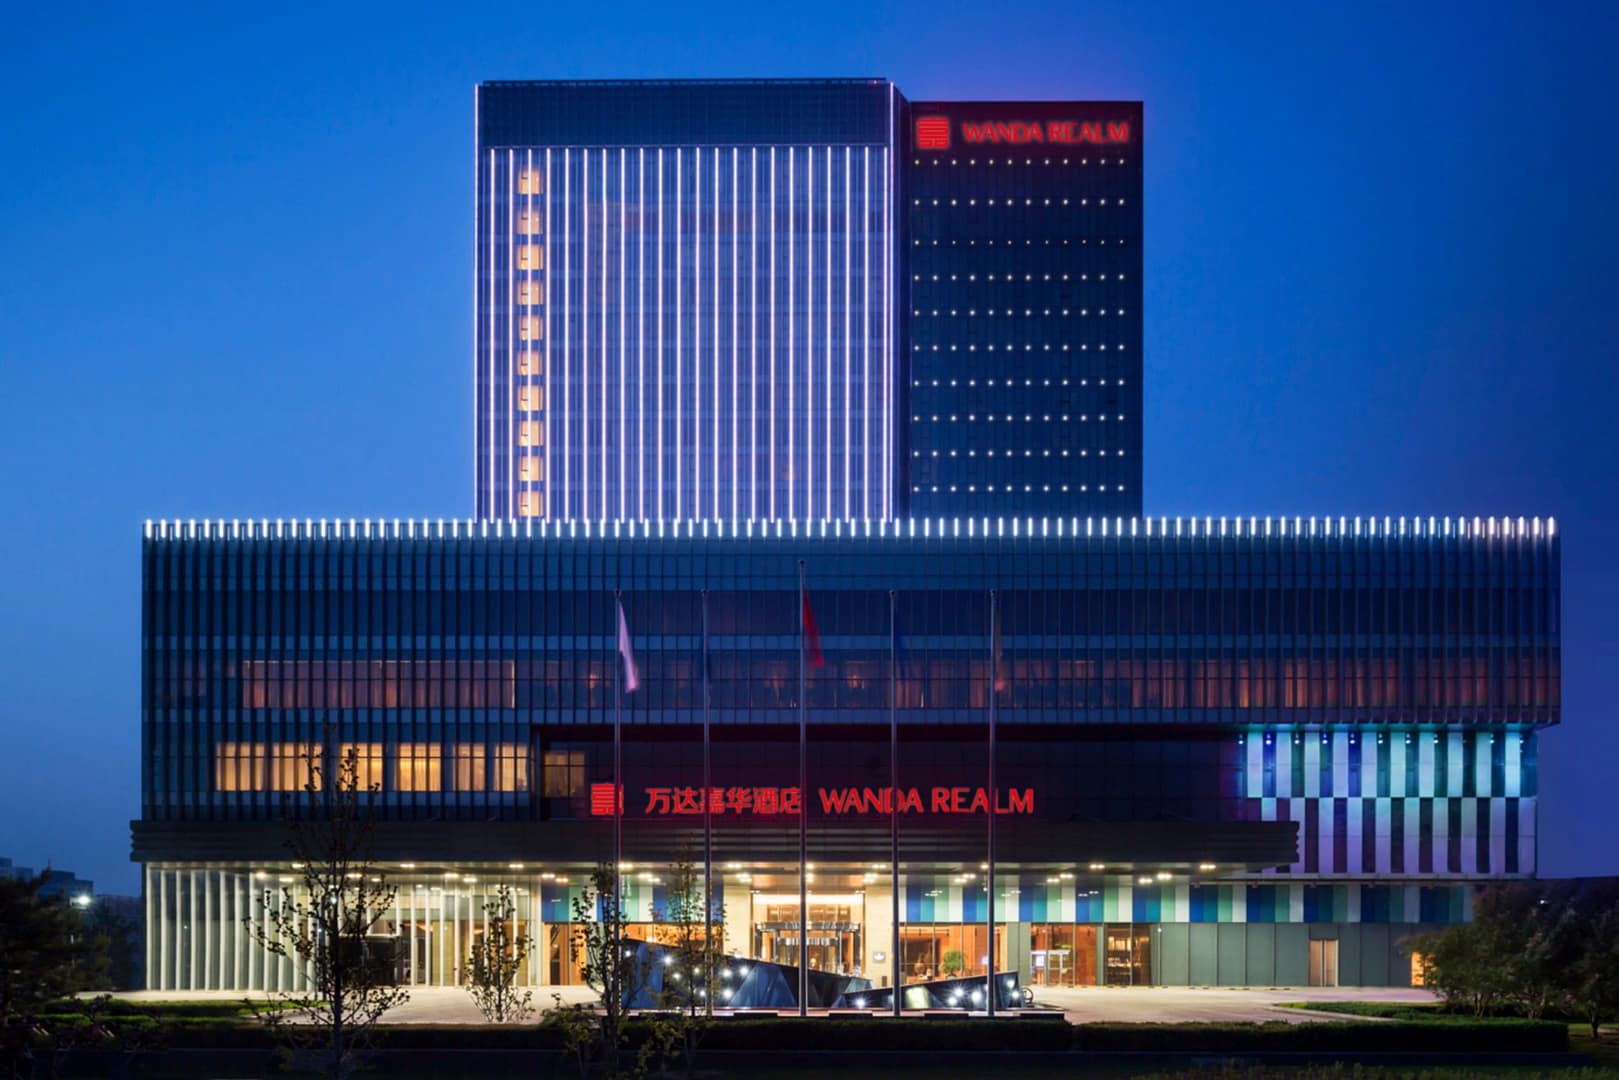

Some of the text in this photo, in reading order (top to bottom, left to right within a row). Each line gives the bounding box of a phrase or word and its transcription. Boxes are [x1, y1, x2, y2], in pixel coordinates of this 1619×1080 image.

[962, 122, 1129, 143] WANDA REALM
[645, 787, 802, 814] 万达嘉华酒店
[819, 787, 1034, 814] WANDA REALM
